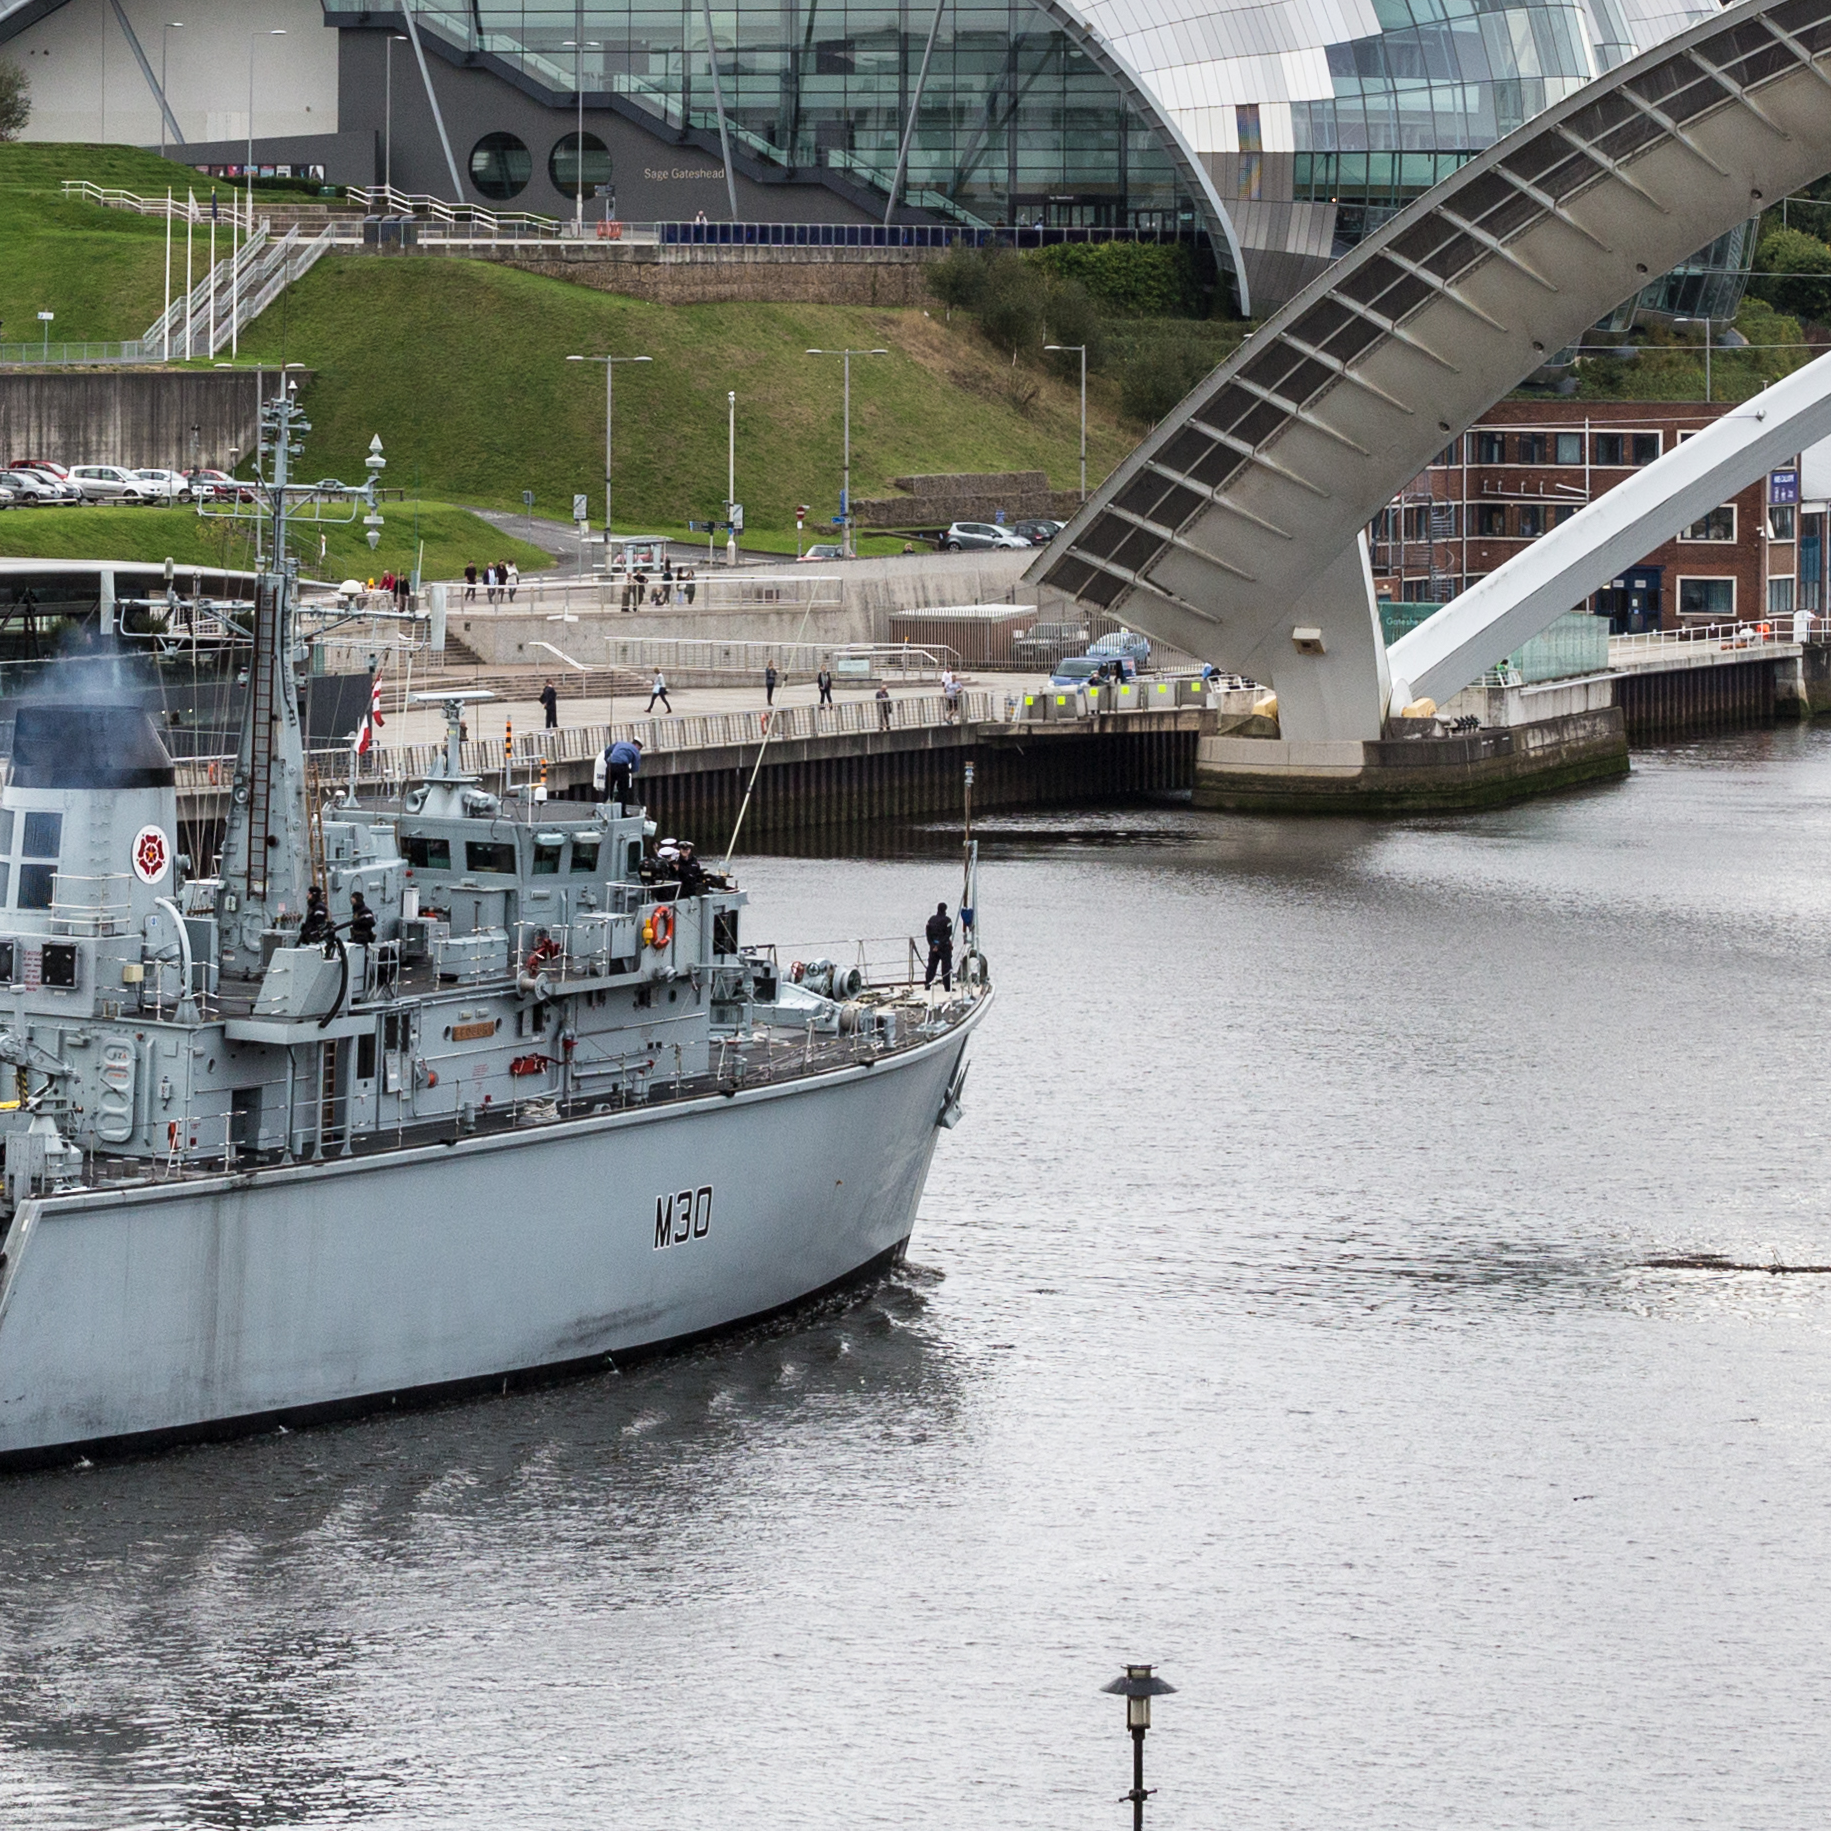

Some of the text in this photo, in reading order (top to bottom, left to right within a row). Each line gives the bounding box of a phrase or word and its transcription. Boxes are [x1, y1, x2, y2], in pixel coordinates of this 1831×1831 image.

[644, 167, 725, 181] Sage Gateshead
[653, 1185, 714, 1250] M30
